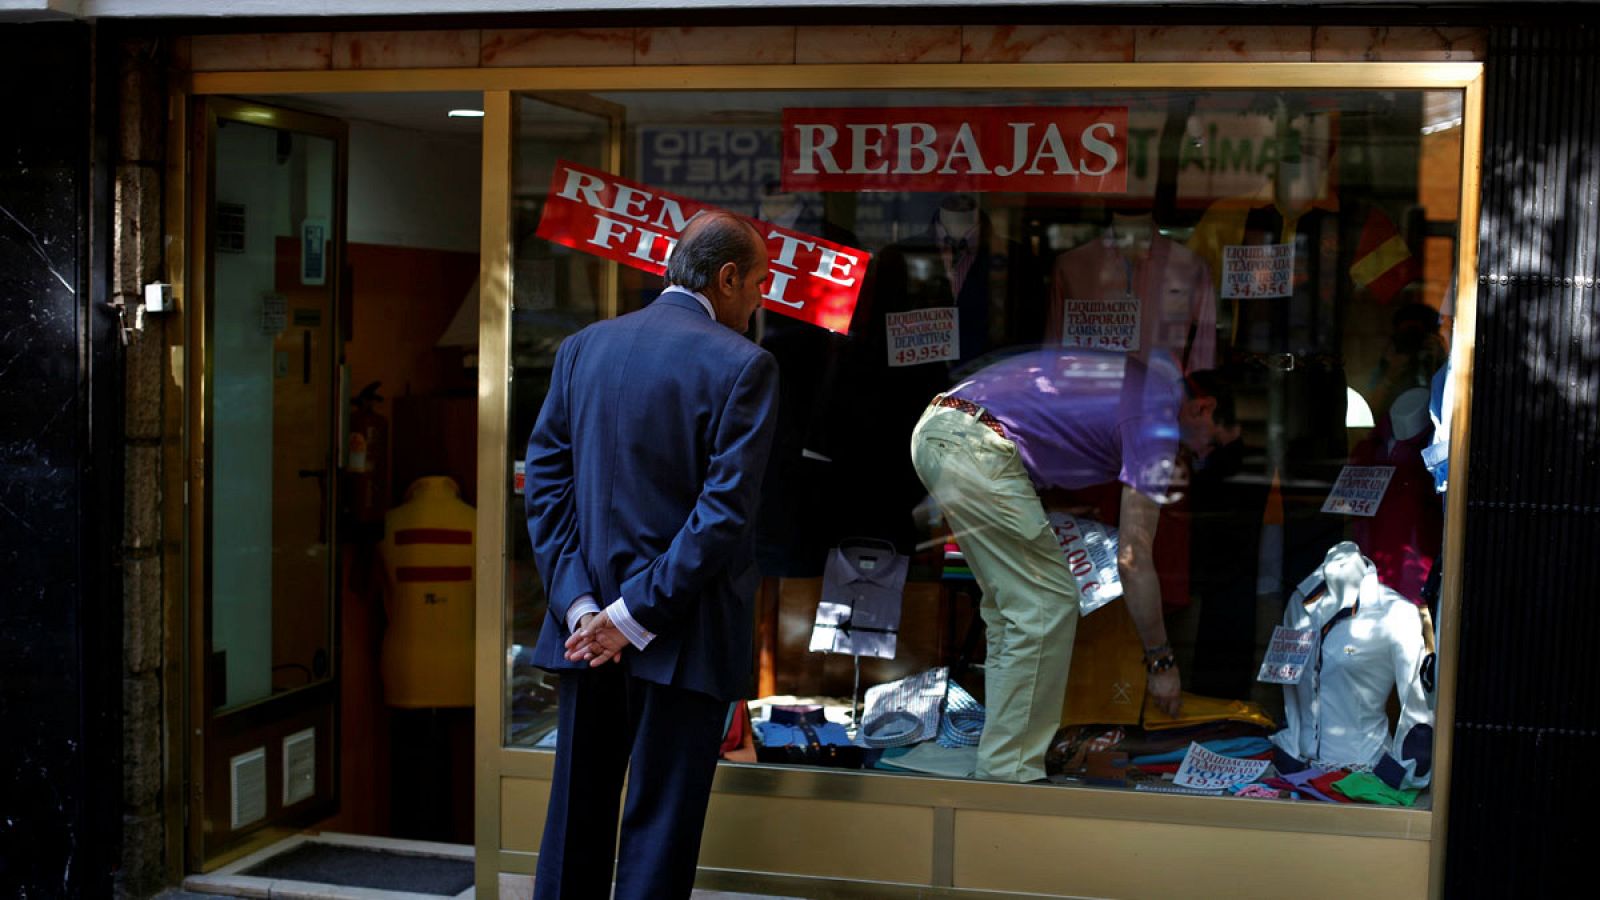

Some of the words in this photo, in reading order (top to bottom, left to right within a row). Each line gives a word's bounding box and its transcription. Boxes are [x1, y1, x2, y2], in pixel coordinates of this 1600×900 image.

[792, 122, 1118, 177] REBAJAS
[556, 168, 859, 288] REMTE
[586, 214, 805, 311] FIL
